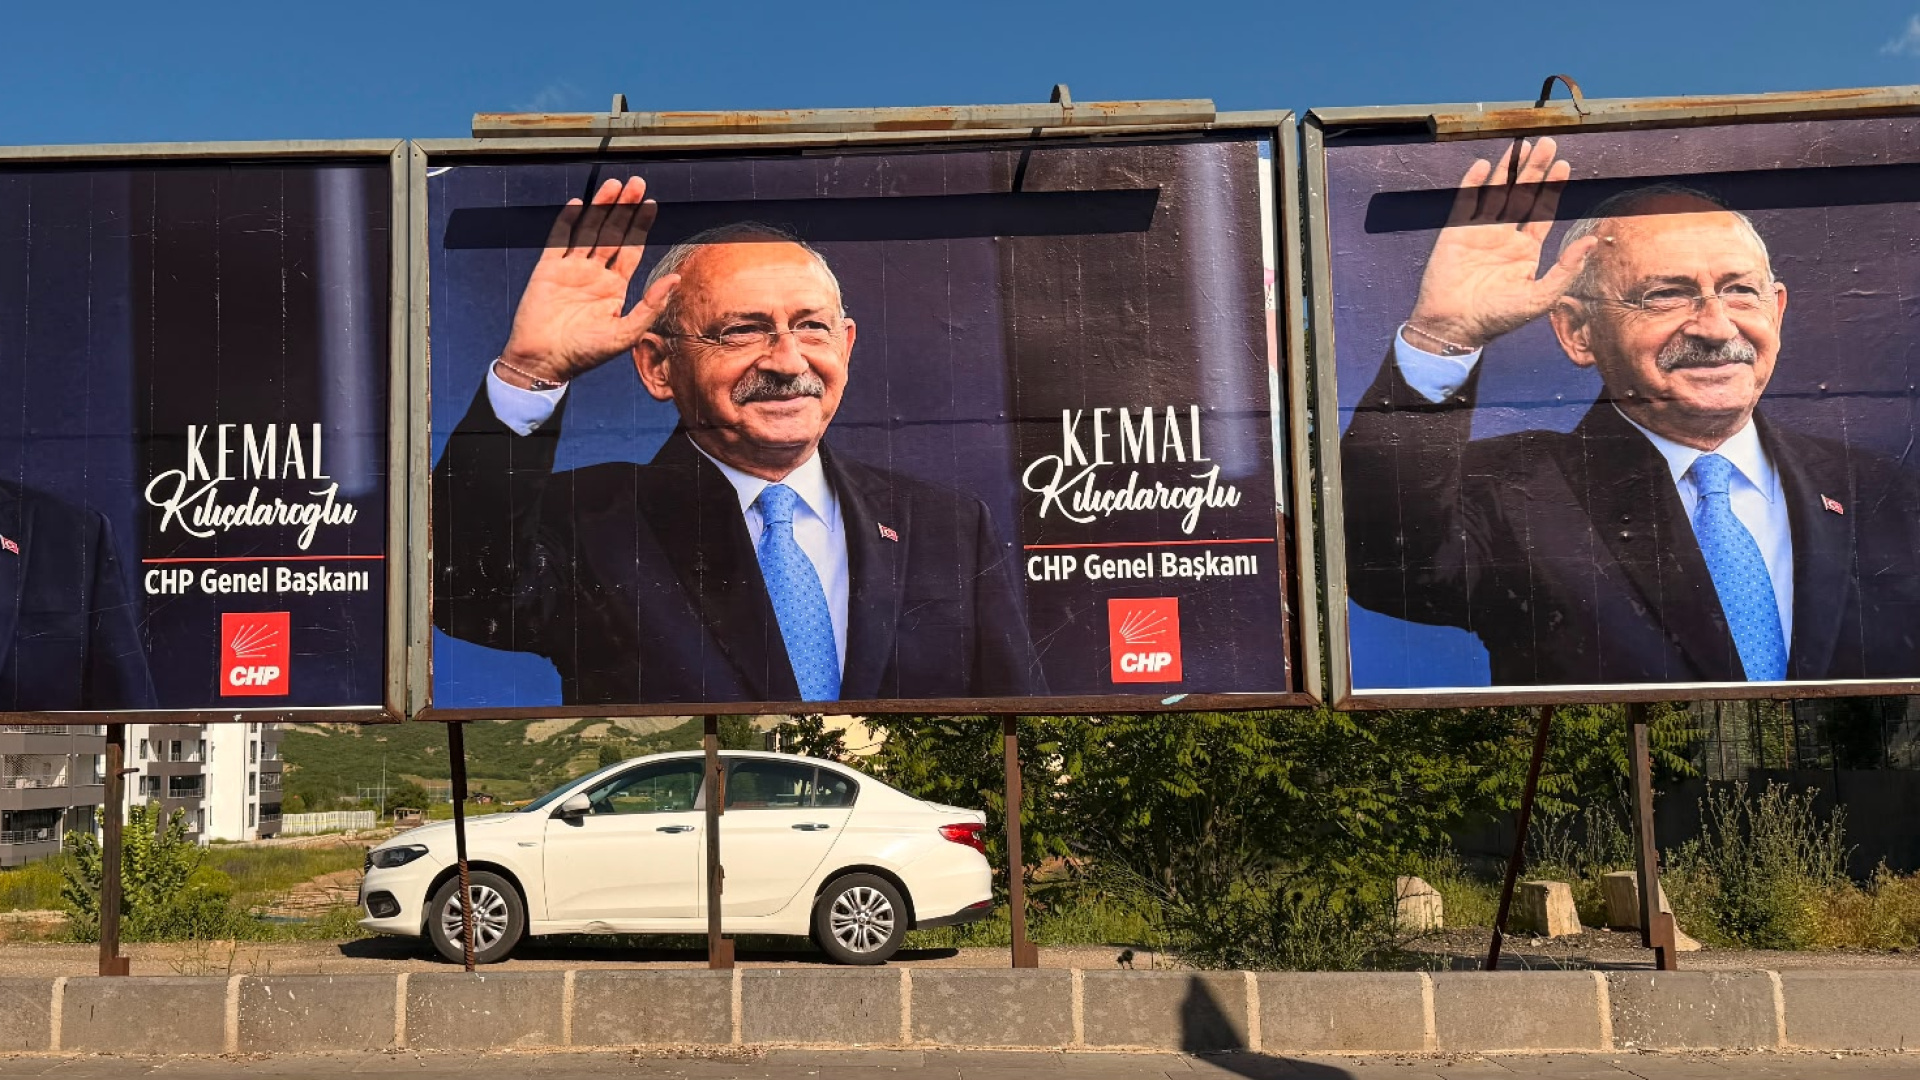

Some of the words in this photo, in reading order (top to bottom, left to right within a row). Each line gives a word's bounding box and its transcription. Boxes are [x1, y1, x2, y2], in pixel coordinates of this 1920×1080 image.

[187, 422, 331, 481] KEMAL
[1062, 404, 1211, 467] KEMAL
[144, 469, 358, 550] Kılıçdaroğlu
[1022, 454, 1241, 535] Kılıçdaroğlu
[144, 569, 194, 594] CHP
[200, 567, 269, 593] Genel
[276, 566, 369, 596] Başkanı
[1027, 555, 1077, 581] CHP
[1084, 552, 1154, 580] Genel
[1161, 550, 1258, 581] Başkanı
[229, 665, 281, 687] CHP
[1120, 651, 1172, 673] CHP
